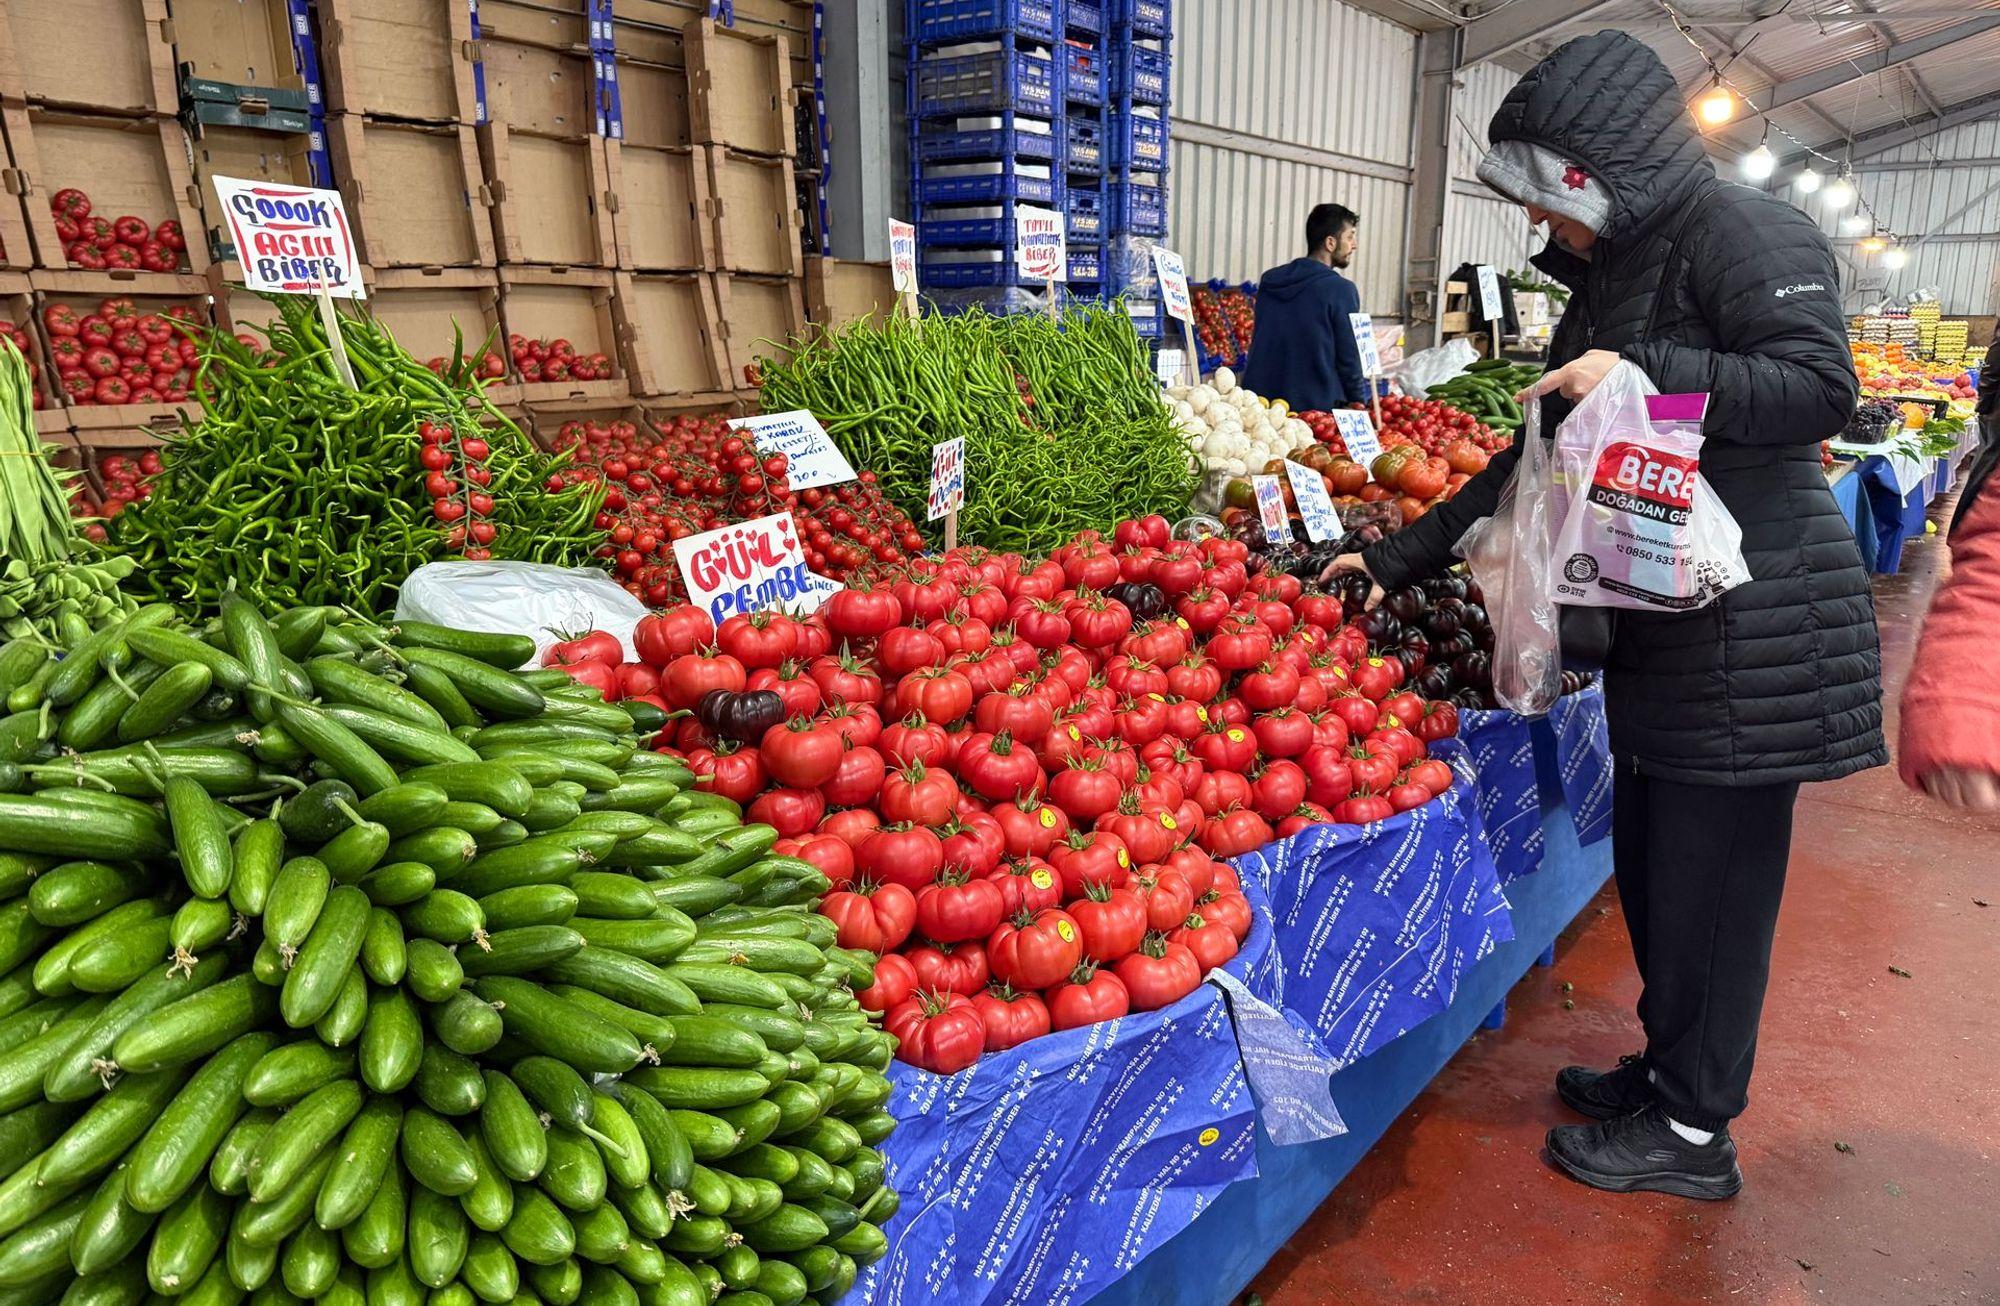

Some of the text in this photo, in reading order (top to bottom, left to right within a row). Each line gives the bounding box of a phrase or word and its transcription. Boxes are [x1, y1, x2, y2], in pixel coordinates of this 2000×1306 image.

[1785, 283, 1825, 294] Columbia
[1596, 491, 1666, 519] DOĞADAN
[690, 529, 787, 592] GÜL
[1625, 546, 1653, 560] 0850
[1655, 554, 1676, 566] 533
[710, 561, 813, 628] PEMBE
[1350, 1012, 1370, 1046] AYRAMPAŞA
[1066, 1064, 1080, 1080] HAS
[1210, 1070, 1236, 1104] HAS İNAN
[919, 1098, 932, 1114] 102
[969, 1106, 1004, 1163] BAYRAMPAŞA
[1016, 1060, 1028, 1076] 102
[1089, 1185, 1100, 1202] HAS
[1096, 1164, 1111, 1184] İNAN
[1144, 1103, 1157, 1117] HAL
[1155, 1090, 1165, 1102] NO
[1165, 1077, 1176, 1090] 102
[1143, 1117, 1161, 1138] LİDER
[982, 1129, 1005, 1168] KALİTEDE
[974, 1129, 1054, 1277] HAS İNAN BAYRAMPAŞA HAL NO 102
[1006, 1198, 1029, 1239] KALİTEDE
[1114, 1250, 1125, 1268] HAS
[1179, 1143, 1191, 1155] 102
[1141, 1194, 1161, 1232] KALİTEDE
[1053, 1251, 1079, 1297] HAL NO 102
